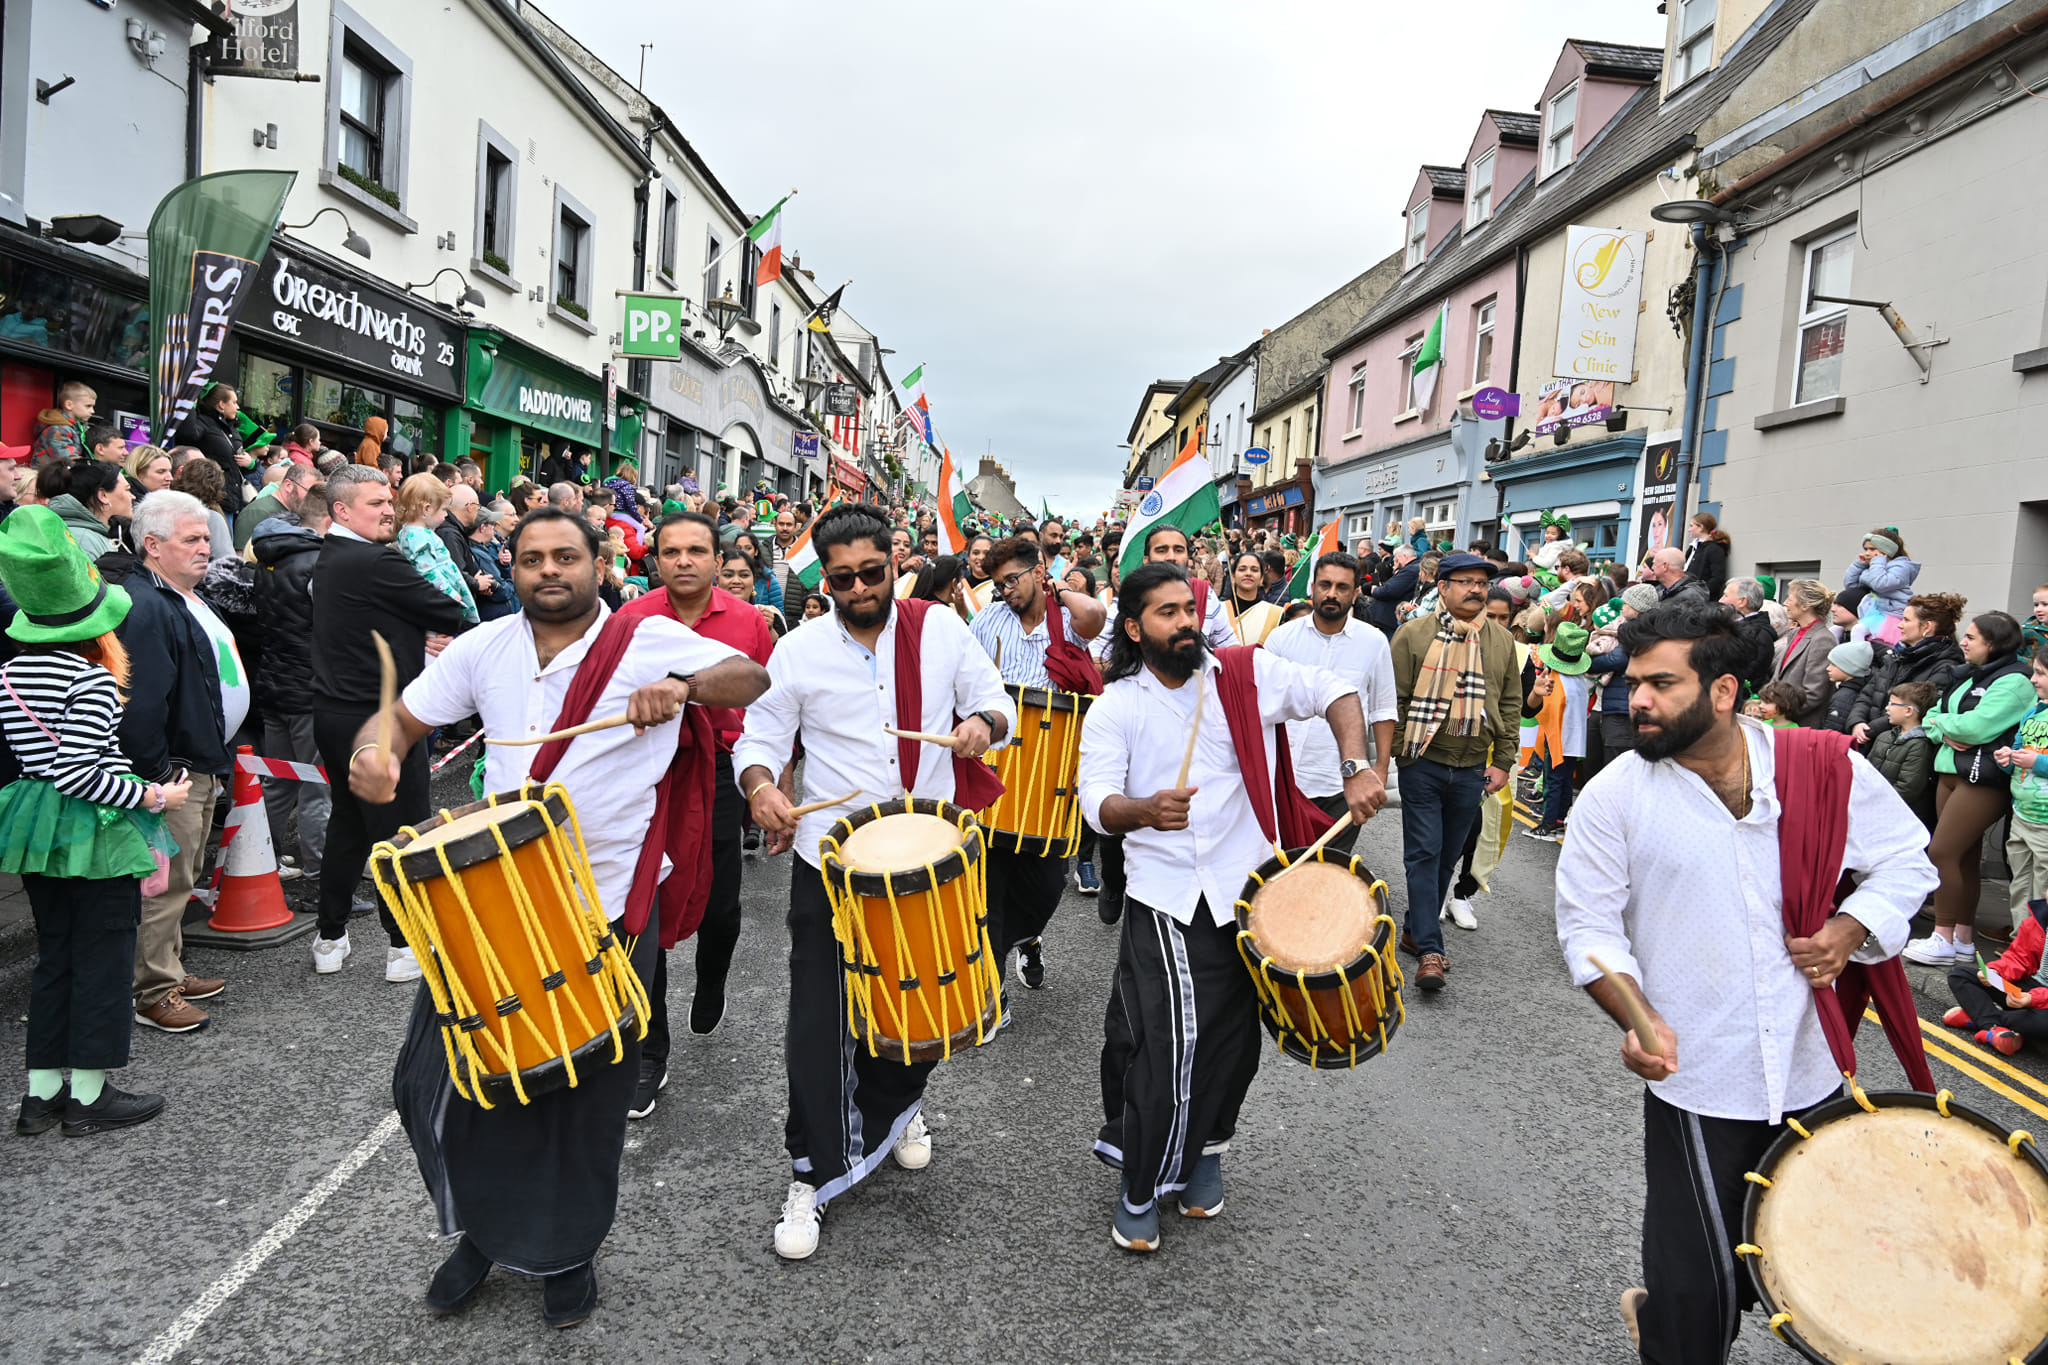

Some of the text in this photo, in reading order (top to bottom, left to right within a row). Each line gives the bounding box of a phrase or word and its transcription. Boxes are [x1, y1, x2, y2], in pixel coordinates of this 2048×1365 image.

[227, 17, 294, 41] ilford
[221, 38, 289, 64] Hotel
[1581, 302, 1621, 322] New
[1578, 330, 1617, 349] Skin
[437, 341, 455, 367] 25
[1573, 356, 1619, 374] Clinic
[1544, 381, 1557, 392] KAY
[832, 396, 851, 407] Hotel
[1480, 392, 1500, 405] Kay
[1582, 411, 1602, 423] 6528
